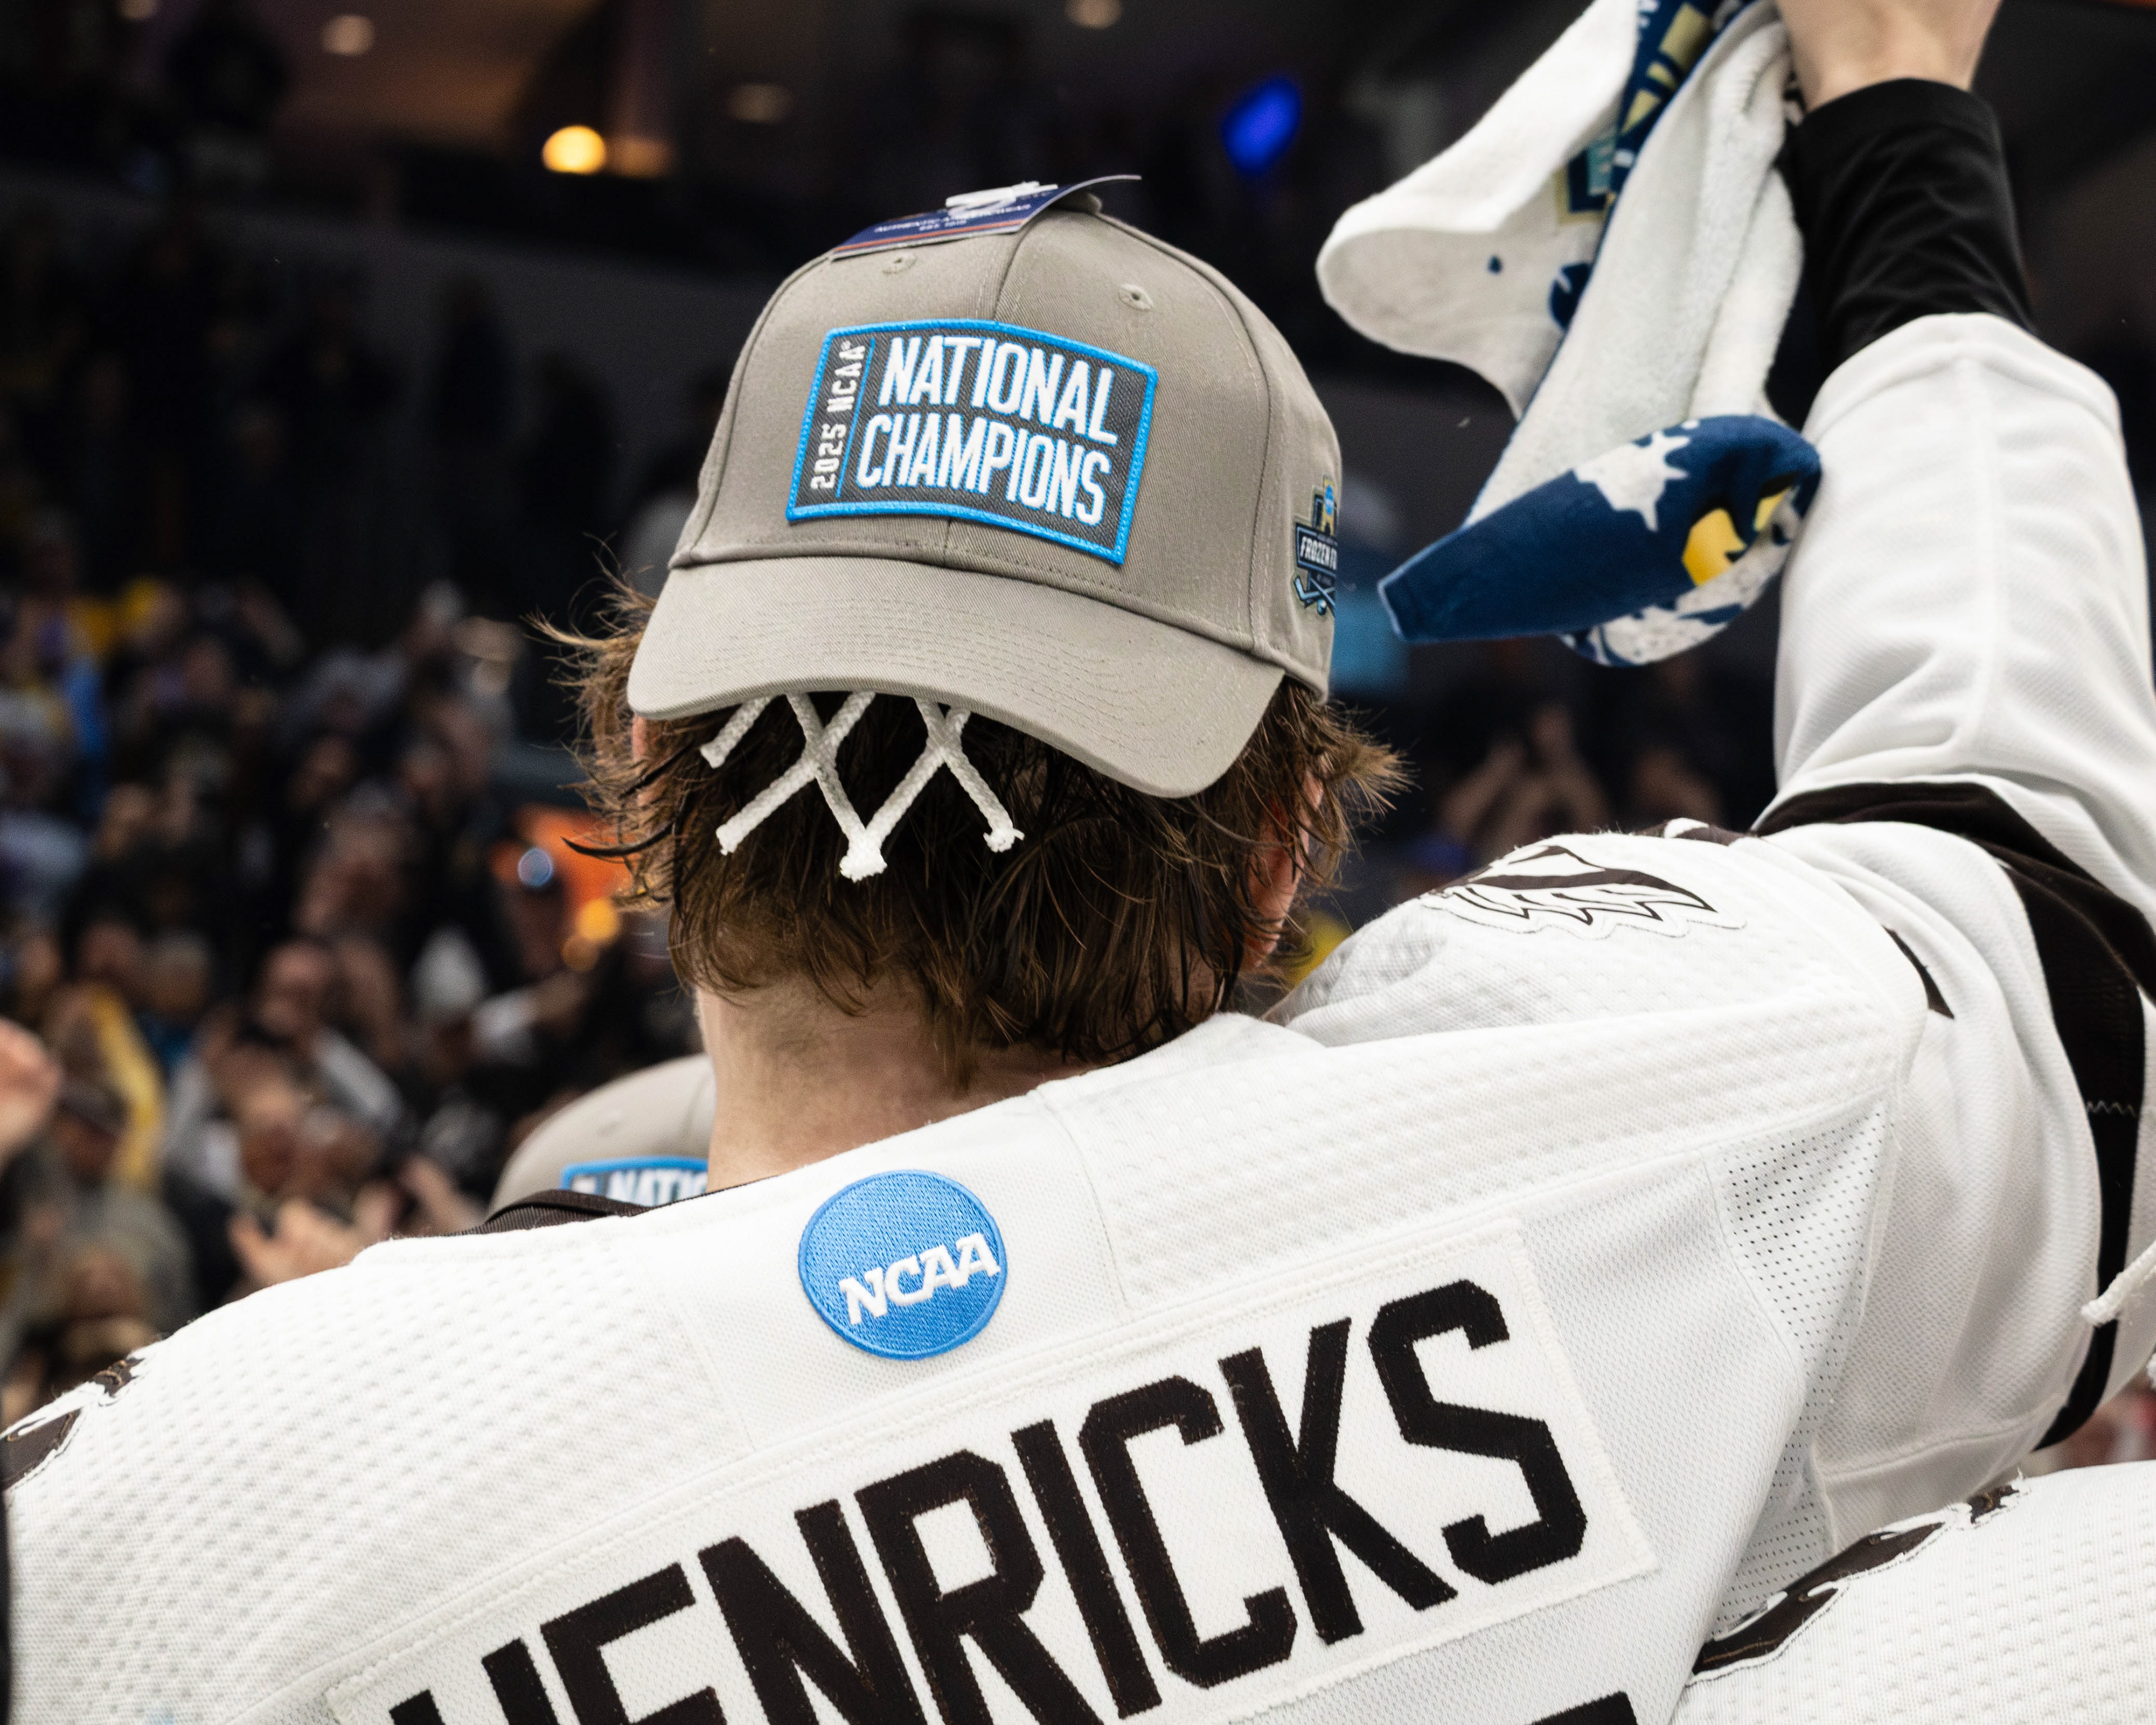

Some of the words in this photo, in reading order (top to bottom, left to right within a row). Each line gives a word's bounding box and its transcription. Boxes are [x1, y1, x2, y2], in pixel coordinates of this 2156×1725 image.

[878, 335, 1118, 445] NATIONAL
[810, 423, 847, 490] 2025
[856, 412, 1112, 526] CHAMPIONS
[1299, 535, 1330, 567] FROZEN
[838, 1231, 1002, 1325] NCAA
[389, 1279, 1589, 1725] NRICKS
